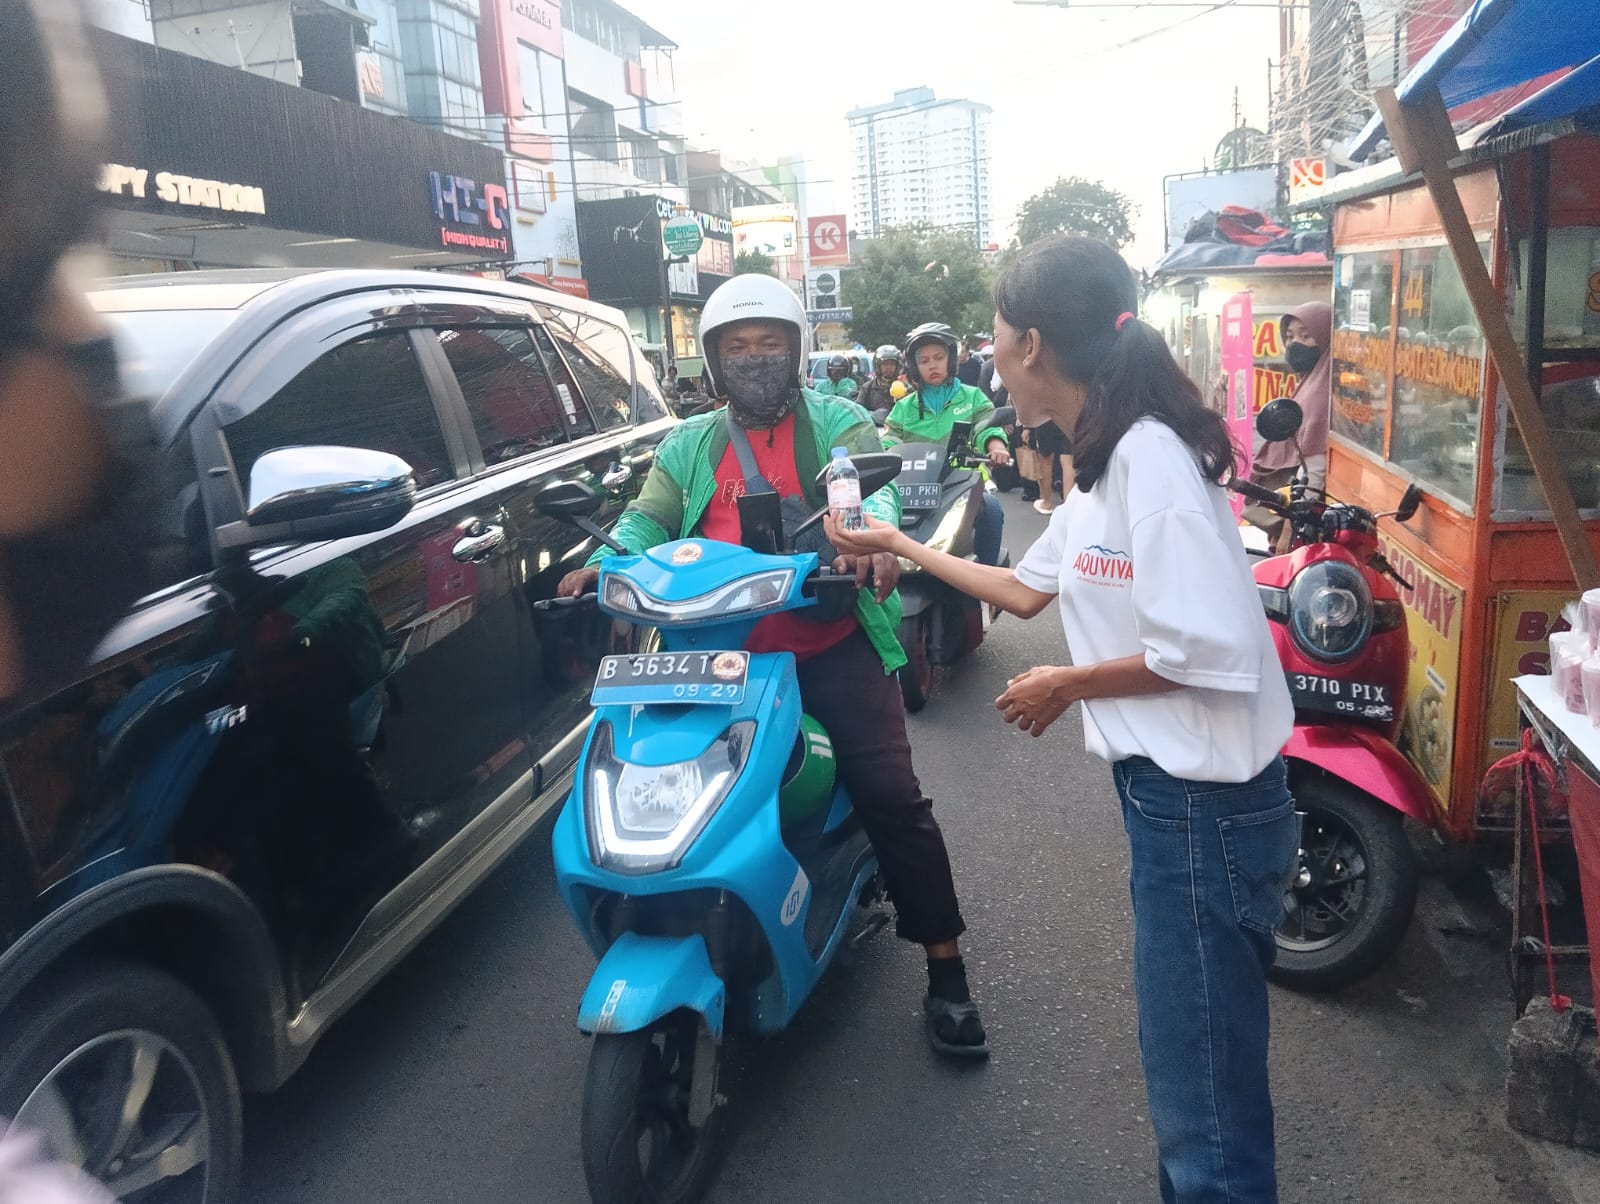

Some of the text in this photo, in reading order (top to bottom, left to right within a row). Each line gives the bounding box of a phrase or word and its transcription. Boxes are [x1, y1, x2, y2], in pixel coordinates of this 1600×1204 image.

[155, 172, 266, 215] STATION
[732, 301, 764, 309] HONDA
[918, 485, 939, 496] PKH
[1072, 551, 1134, 581] AQUVIVA
[602, 660, 618, 680] B
[631, 656, 690, 677] 5634
[1296, 674, 1385, 702] 3710 PIX
